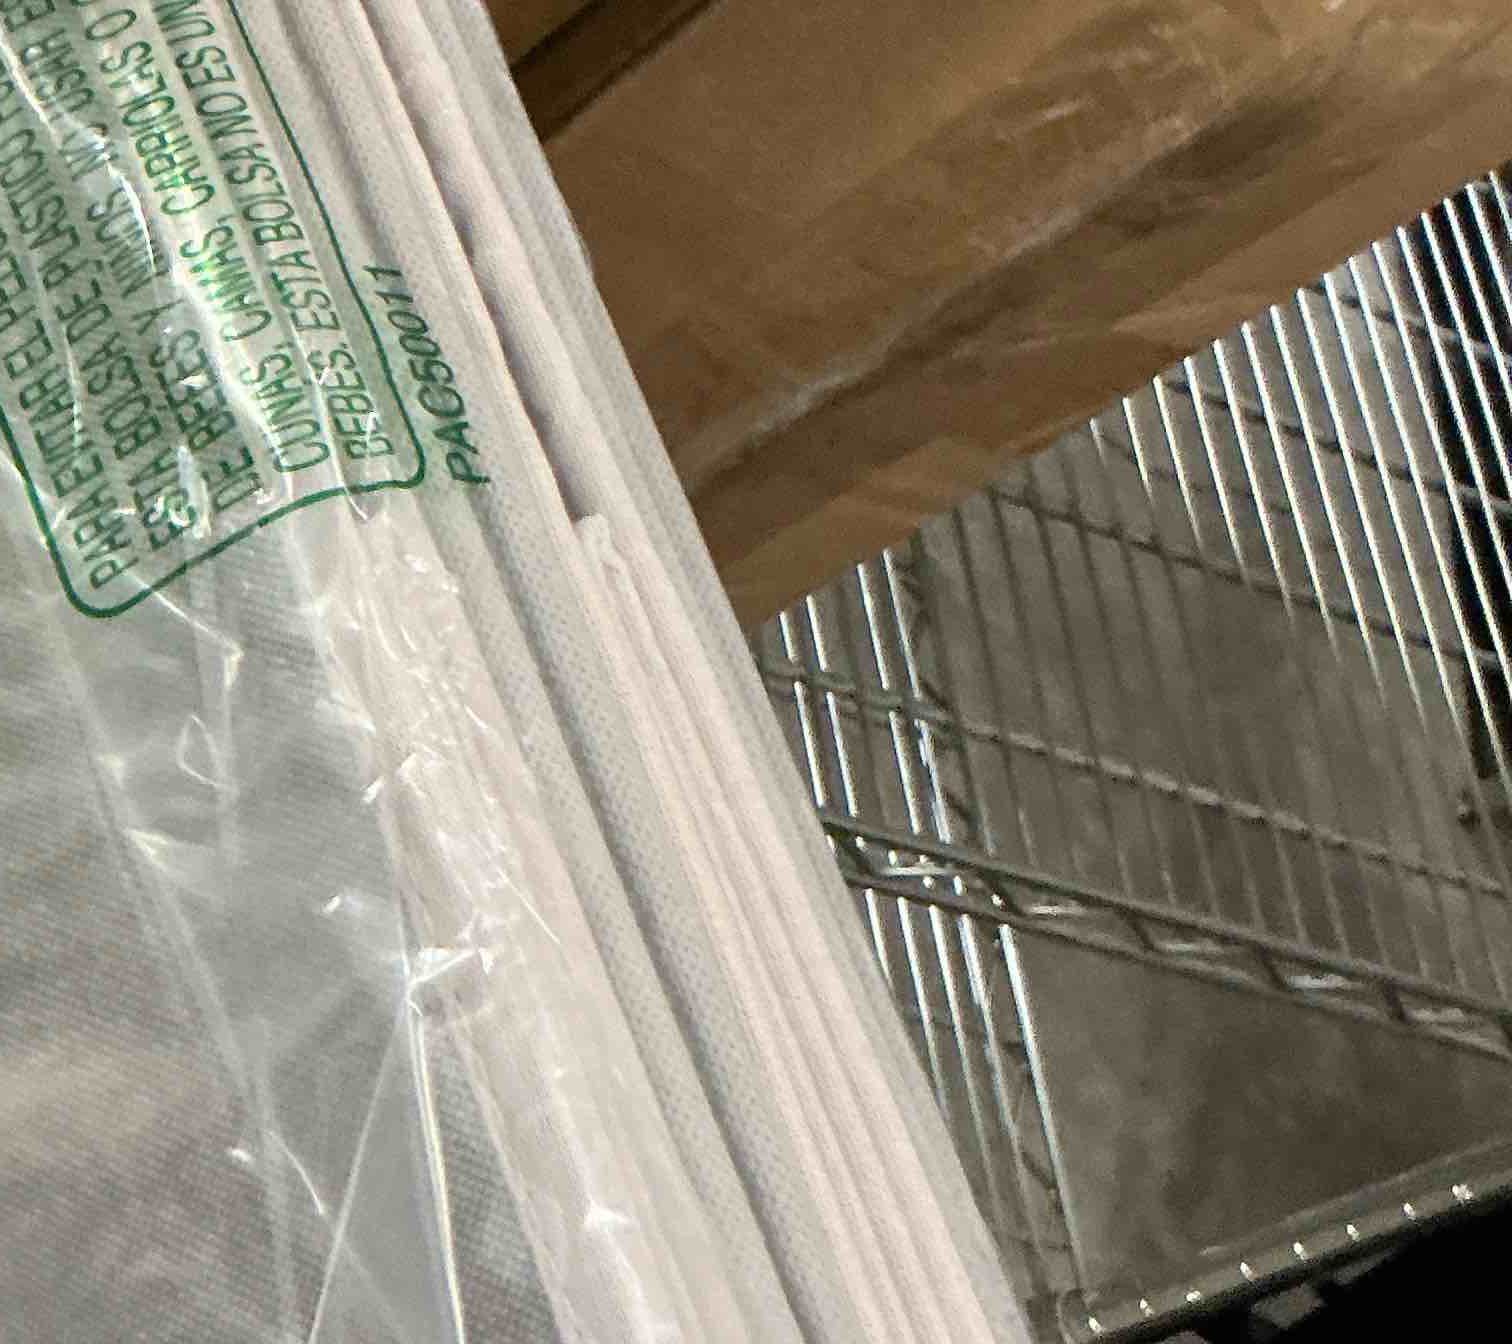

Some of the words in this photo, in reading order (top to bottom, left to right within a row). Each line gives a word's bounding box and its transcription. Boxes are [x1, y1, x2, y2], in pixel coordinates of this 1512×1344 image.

[83, 8, 138, 42] O
[174, 45, 236, 92] ES
[17, 28, 95, 122] USAR
[194, 91, 257, 143] NO
[99, 41, 215, 217] CARRIOLAS
[218, 142, 304, 247] BOLSA
[54, 278, 113, 344] DE
[131, 297, 188, 336] Y
[179, 214, 273, 342] CAMAS,
[265, 250, 341, 332] ESTA
[1, 318, 54, 381] EL
[365, 266, 491, 487] PAC50011
[18, 365, 104, 498] EVITAR
[79, 331, 163, 460] BOLSA
[200, 445, 264, 515] DE
[66, 483, 140, 590] PARA
